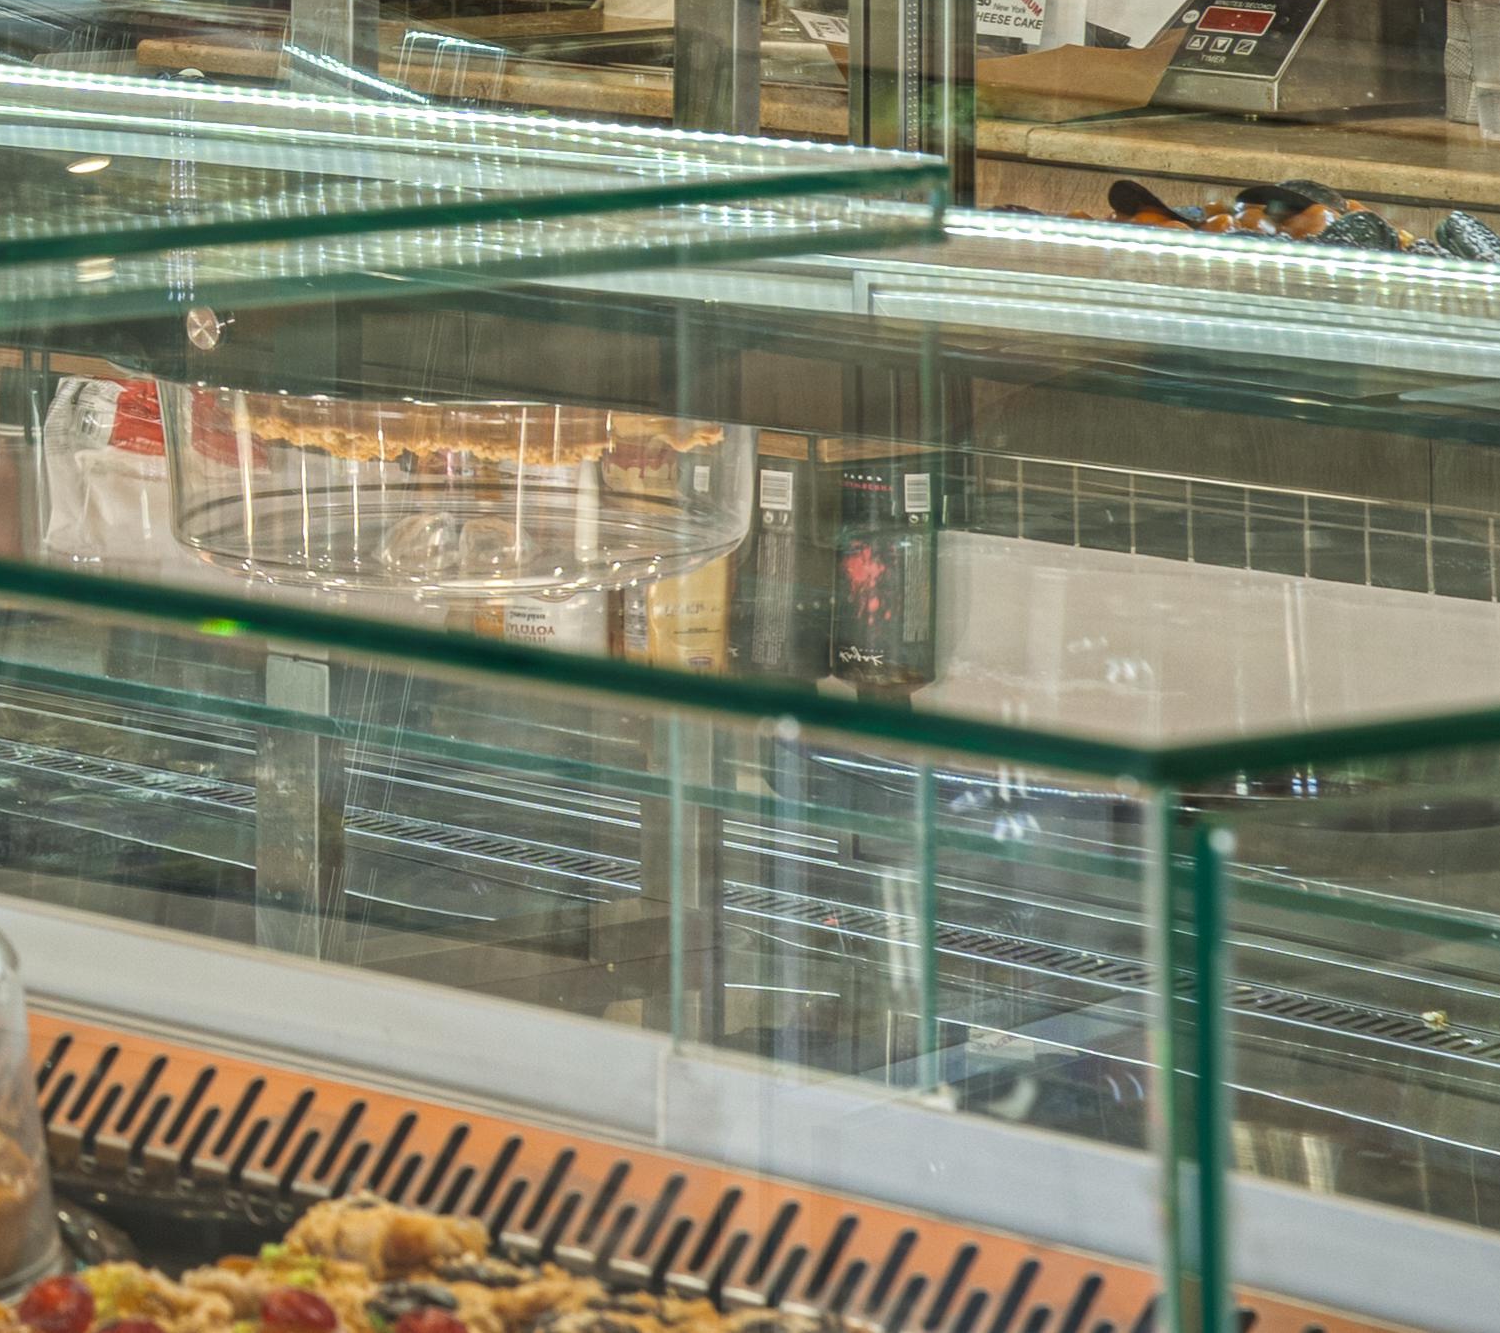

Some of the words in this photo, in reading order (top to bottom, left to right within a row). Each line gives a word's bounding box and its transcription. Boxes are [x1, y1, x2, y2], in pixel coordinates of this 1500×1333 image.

[976, 12, 1012, 26] HEESE
[1014, 17, 1043, 30] CAKE
[1200, 54, 1226, 64] TIMER
